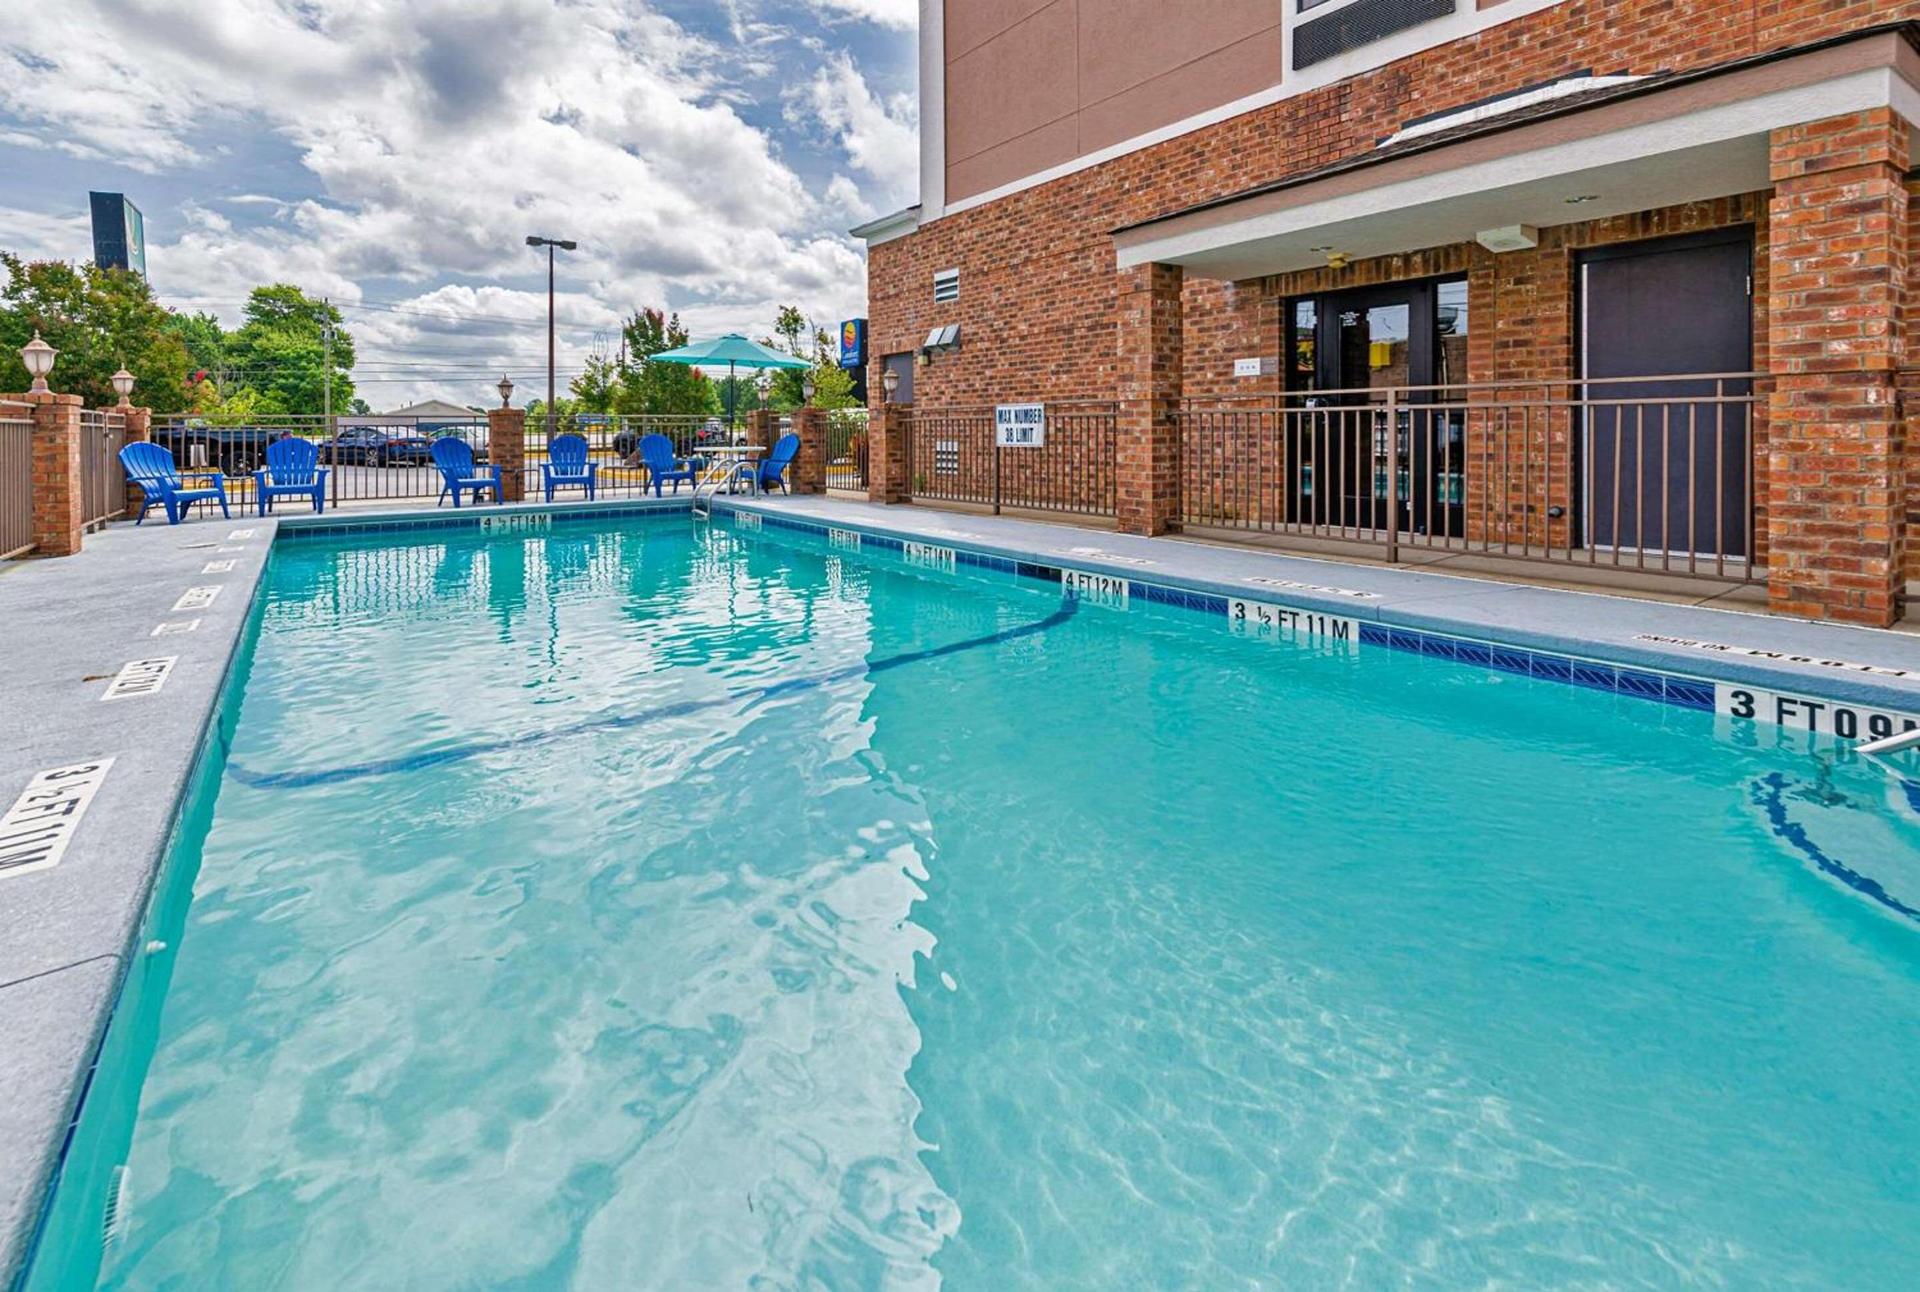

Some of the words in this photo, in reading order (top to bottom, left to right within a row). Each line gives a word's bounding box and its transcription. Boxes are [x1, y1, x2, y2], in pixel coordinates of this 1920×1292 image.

[998, 409, 1011, 424] MAX
[1014, 408, 1043, 424] NUMBER
[1016, 427, 1034, 443] LIMIT
[484, 517, 491, 526] 4
[1066, 572, 1074, 585] 4
[1079, 574, 1093, 590] FT
[1235, 602, 1246, 620] 3
[1278, 610, 1300, 630] FT
[1731, 690, 1755, 719] 3
[1776, 696, 1825, 732] FT
[44, 765, 100, 781] 3
[9, 797, 81, 825] FT
